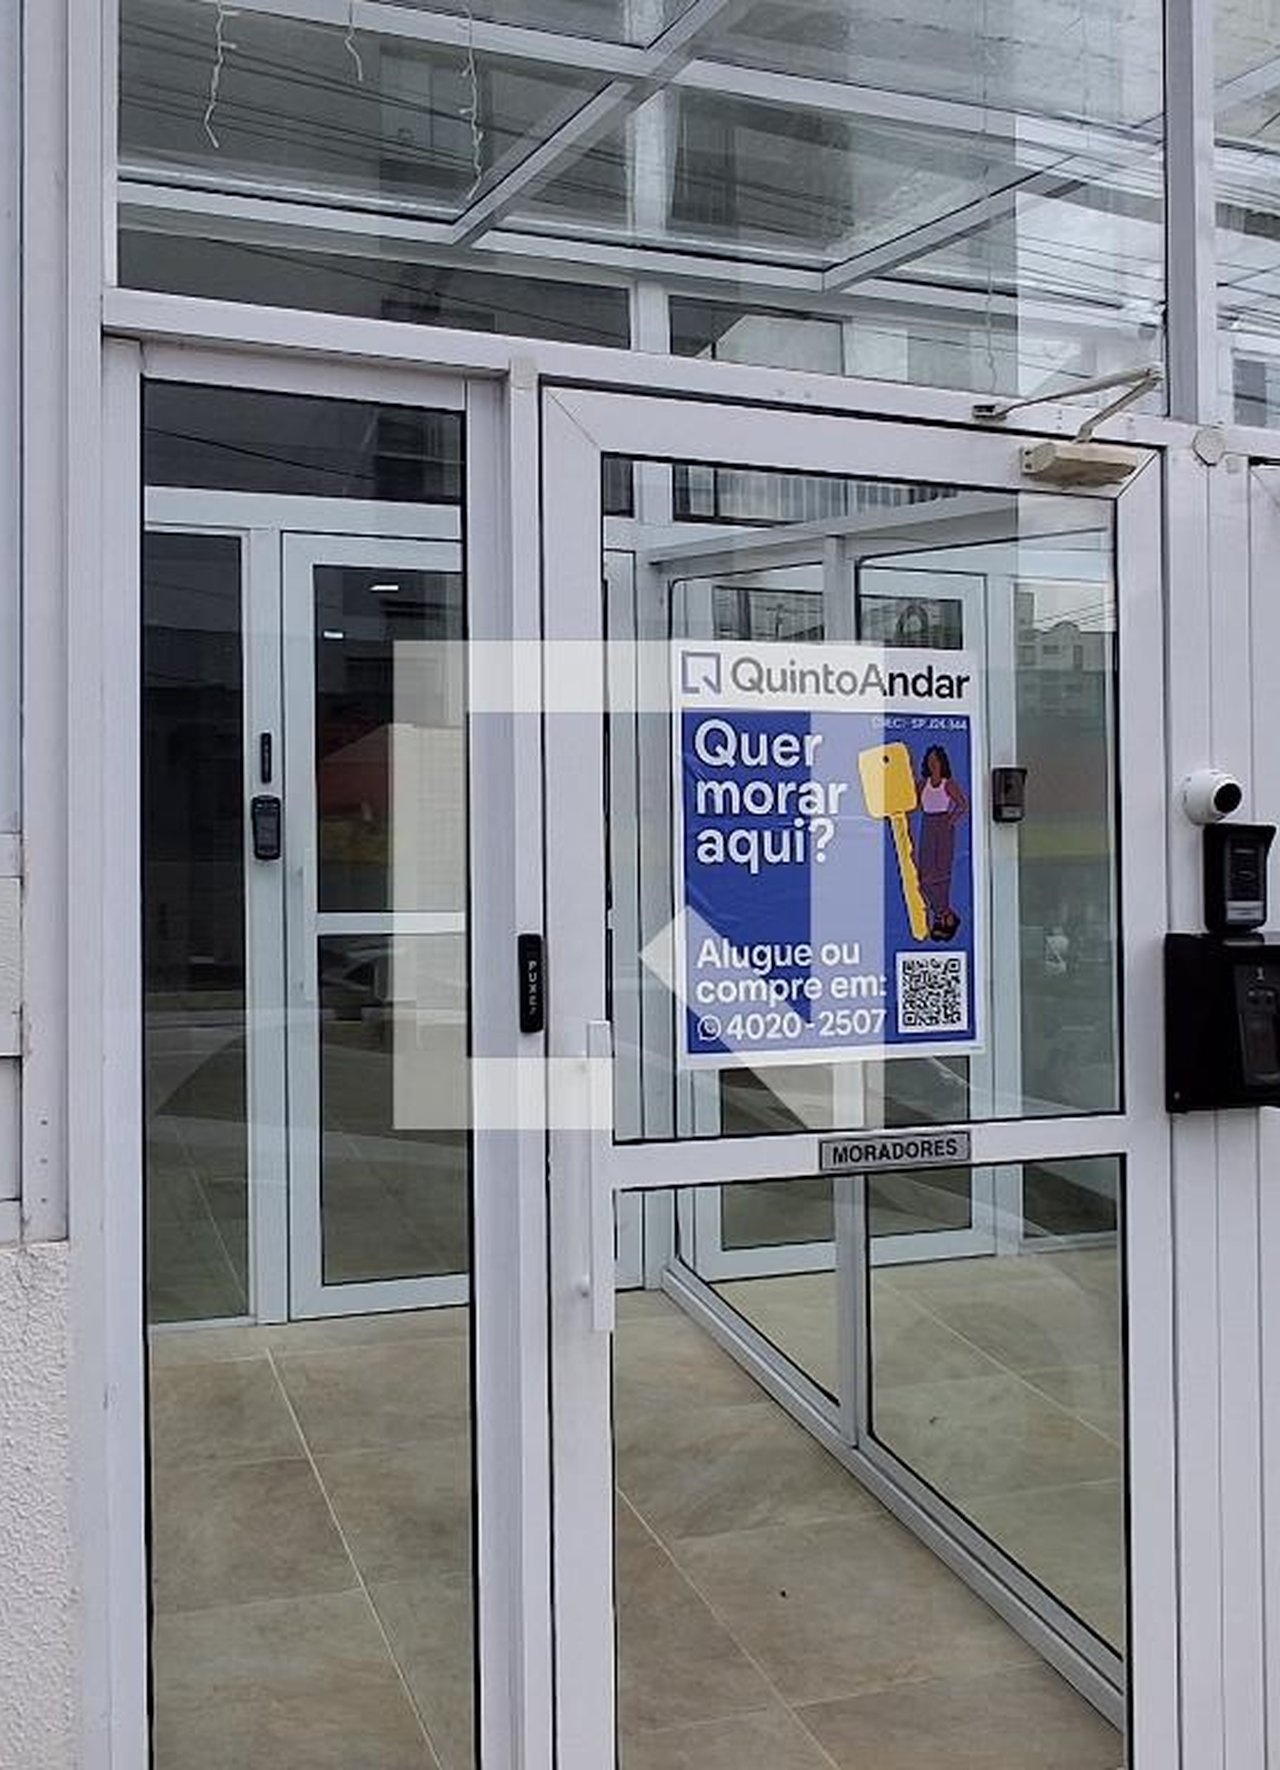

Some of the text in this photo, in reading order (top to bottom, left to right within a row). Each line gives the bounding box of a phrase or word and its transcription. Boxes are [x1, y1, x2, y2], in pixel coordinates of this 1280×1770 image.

[730, 657, 970, 699] QuintoAndar
[694, 719, 824, 768] Quer
[695, 780, 847, 816] morar
[696, 817, 835, 874] aqui?
[696, 938, 860, 975] Alugue ou
[695, 974, 887, 1007] compre em:
[832, 1138, 958, 1165] MORADORES
